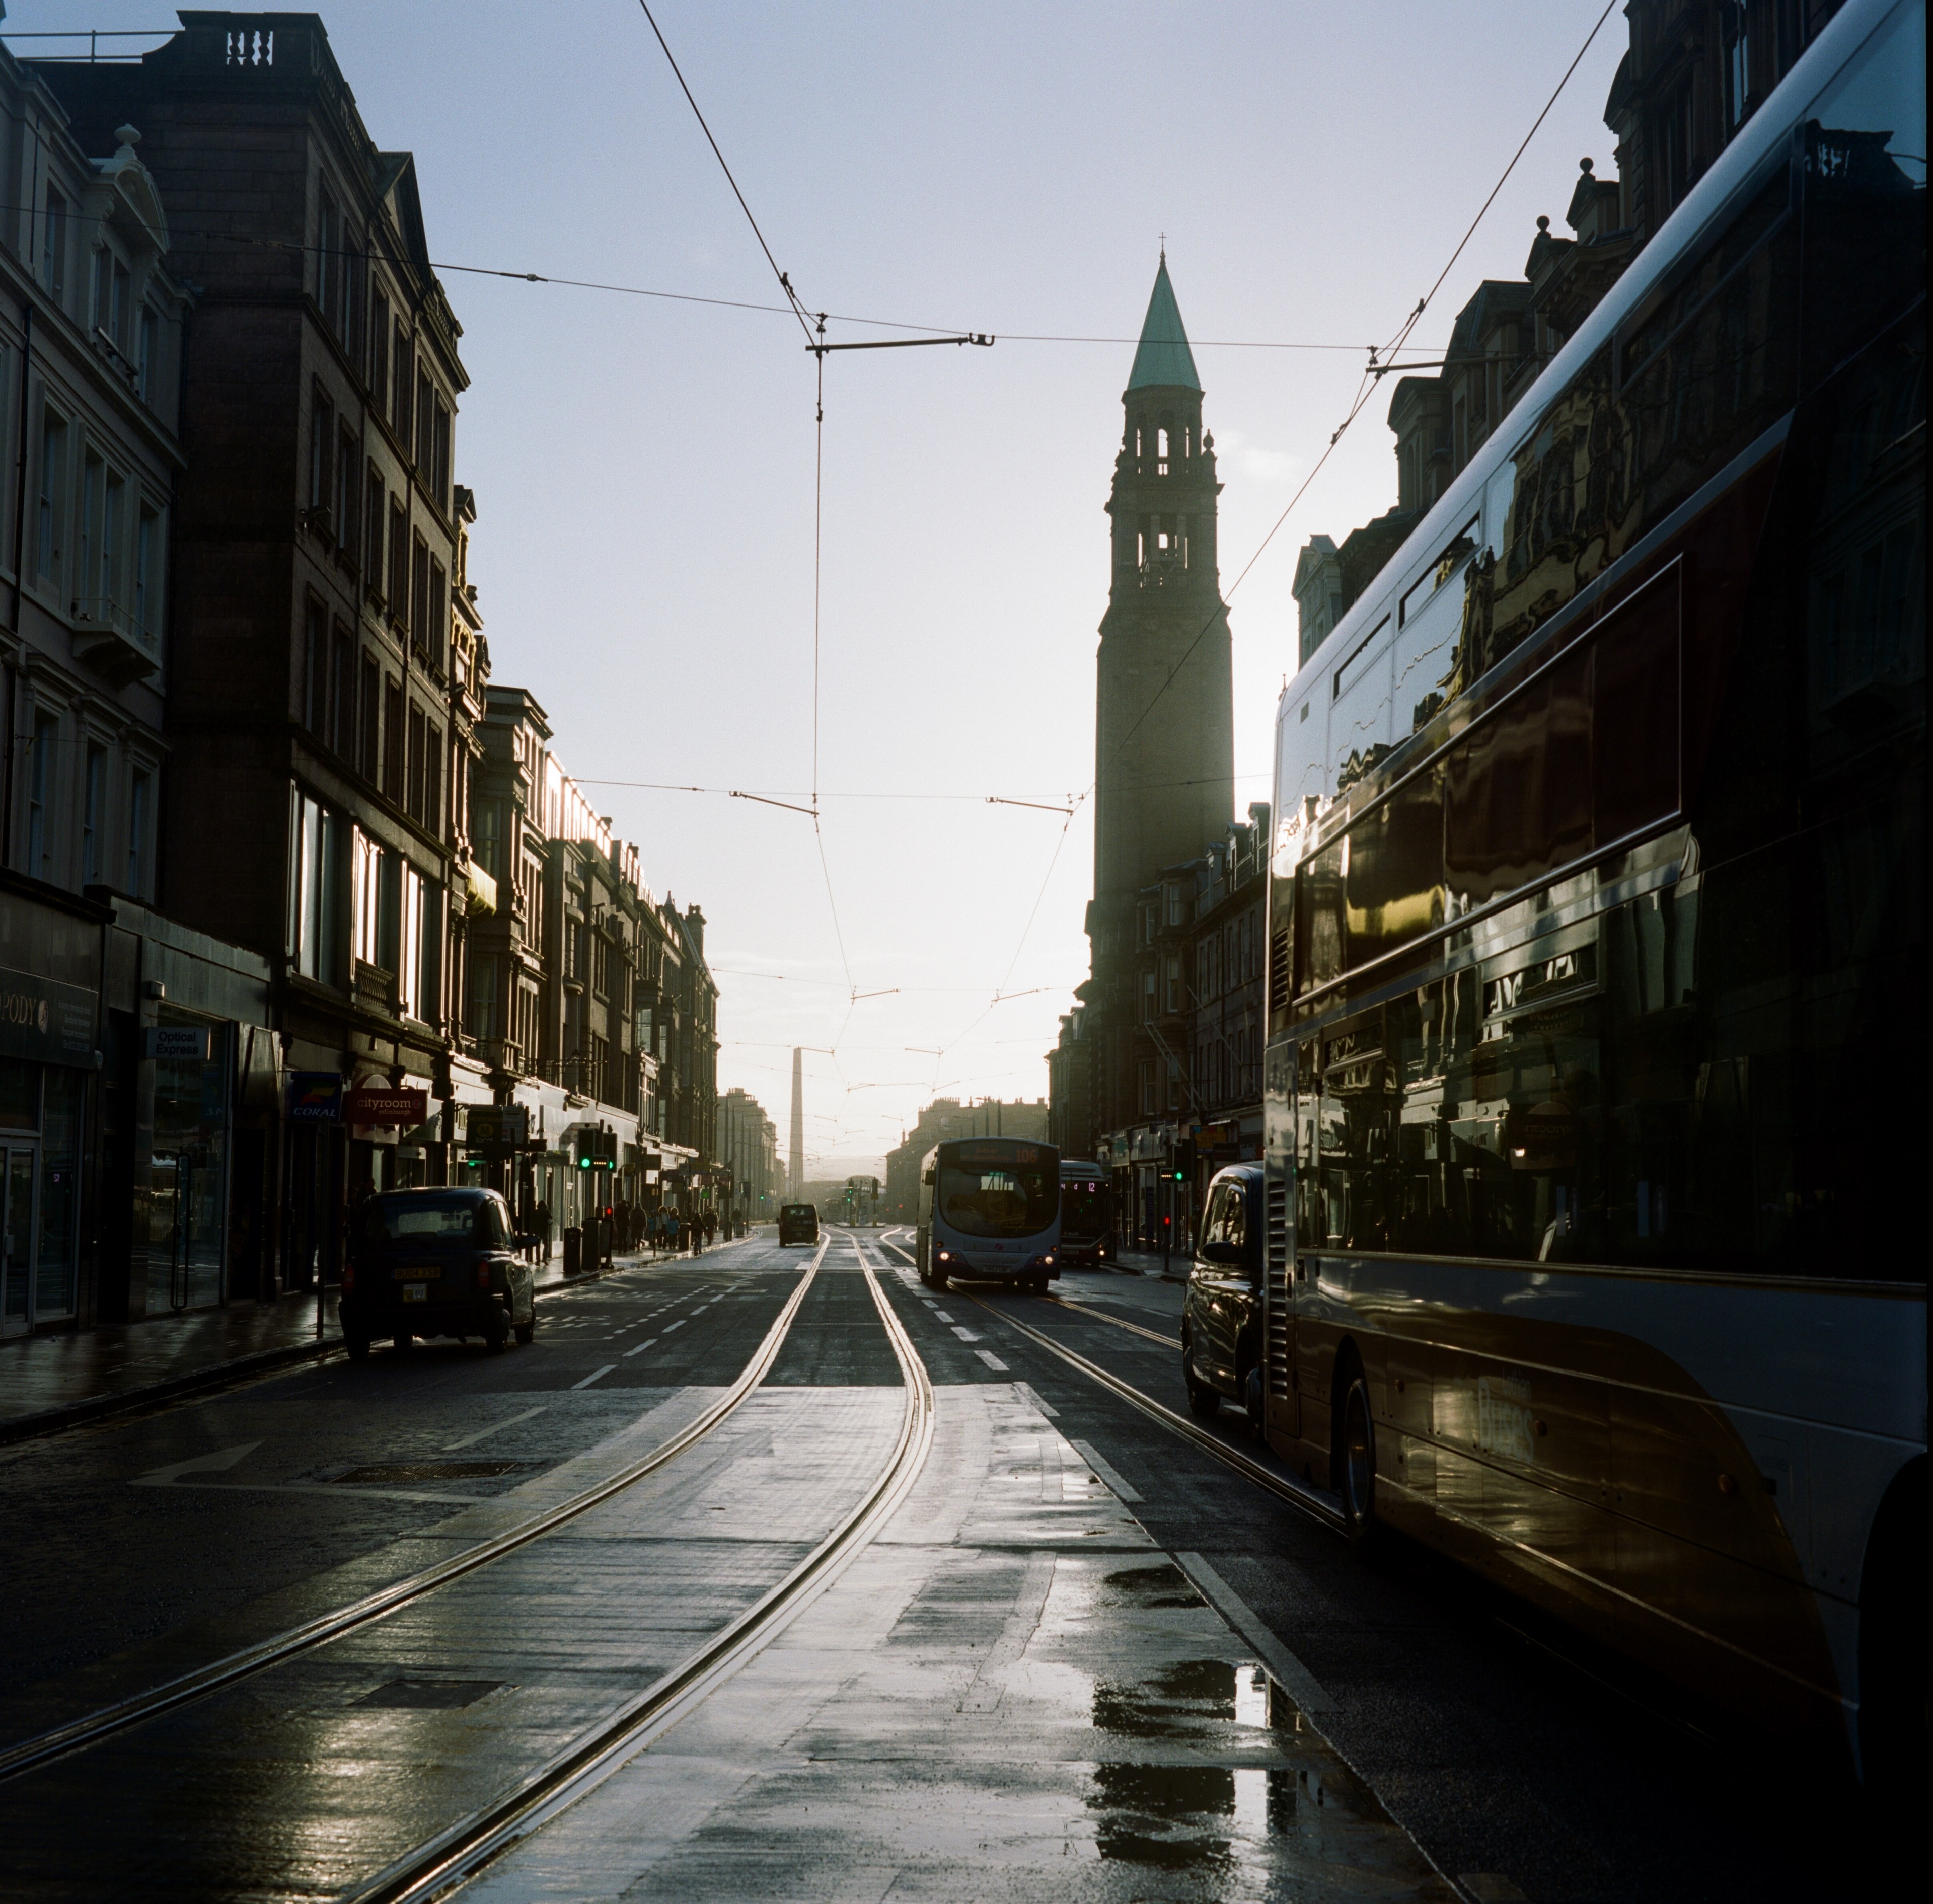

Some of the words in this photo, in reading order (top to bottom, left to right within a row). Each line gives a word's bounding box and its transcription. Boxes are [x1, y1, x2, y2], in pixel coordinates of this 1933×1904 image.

[0, 992, 36, 1025] PODY
[159, 1032, 196, 1043] Optical
[156, 1044, 198, 1056] Express
[357, 1097, 411, 1110] cityroom
[293, 1107, 336, 1117] CORAL
[480, 1126, 490, 1135] M
[1016, 1148, 1037, 1163] 106
[1089, 1182, 1095, 1192] 12
